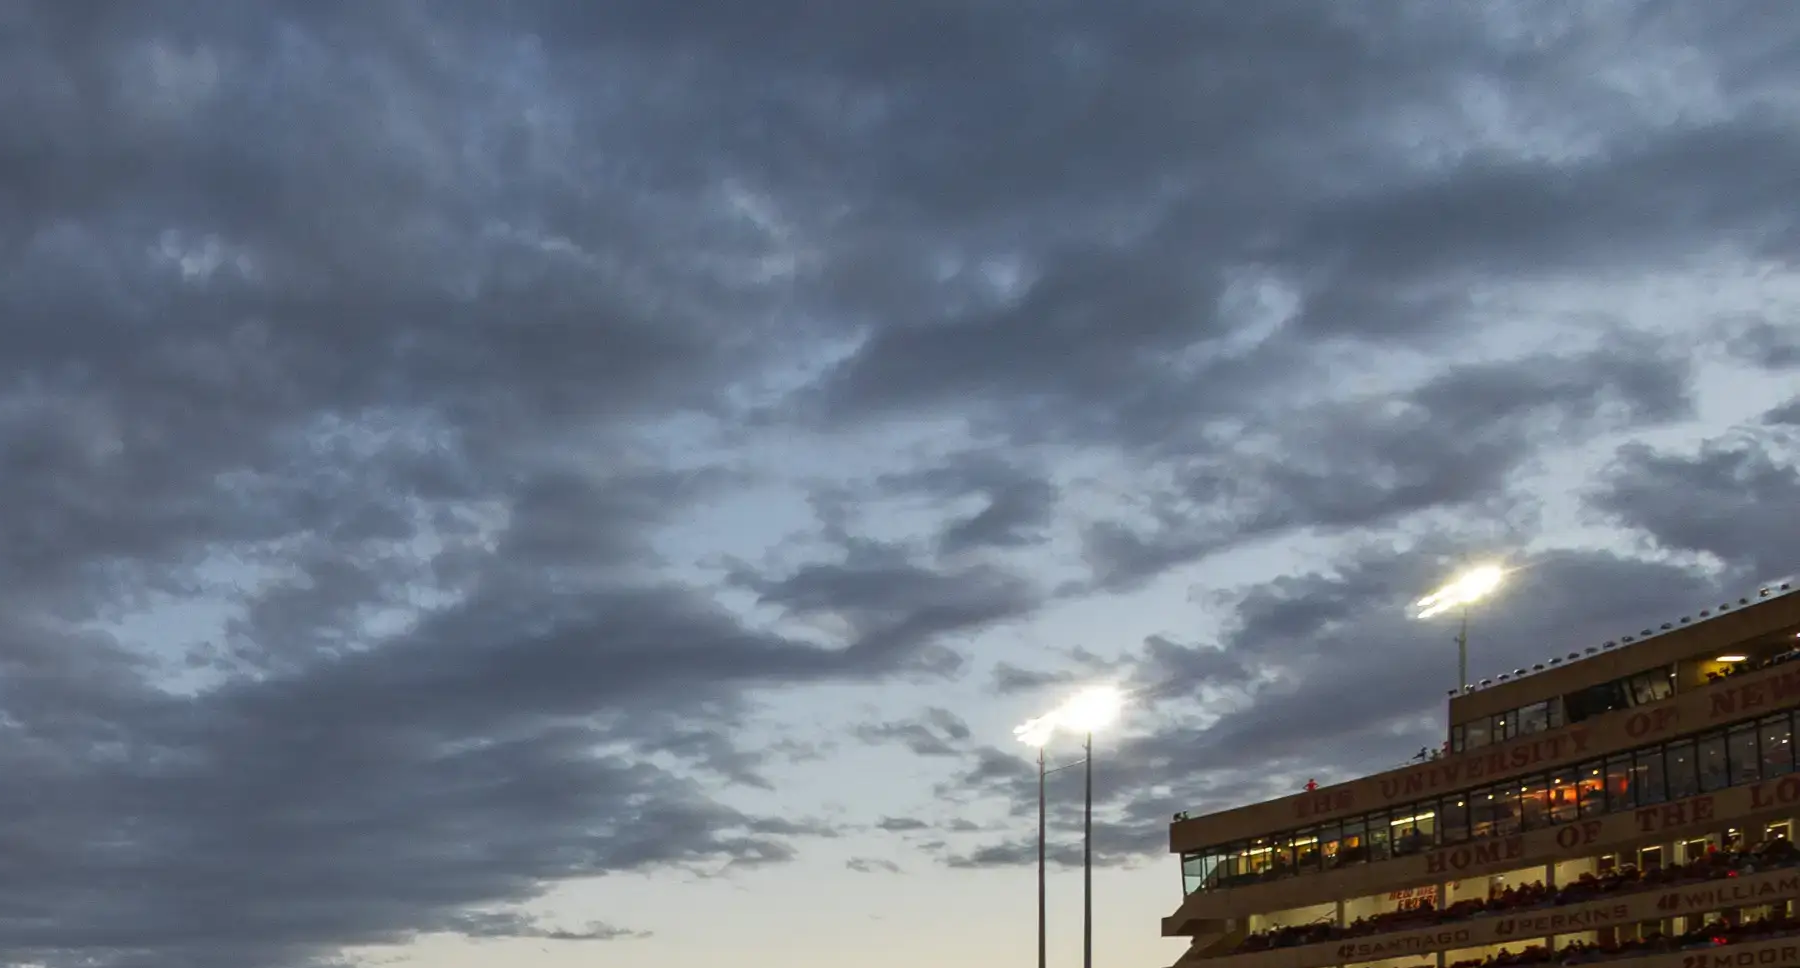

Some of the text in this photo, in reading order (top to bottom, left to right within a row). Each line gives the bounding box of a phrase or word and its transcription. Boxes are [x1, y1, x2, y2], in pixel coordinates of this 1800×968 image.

[1379, 728, 1591, 799] UNIVERSITY
[1625, 705, 1679, 738] OF
[1425, 834, 1522, 874] HOME
[1556, 820, 1602, 849] OF
[1635, 796, 1714, 832] THE
[1356, 928, 1470, 956] SANTIAGO
[1519, 904, 1628, 931] PERKINS
